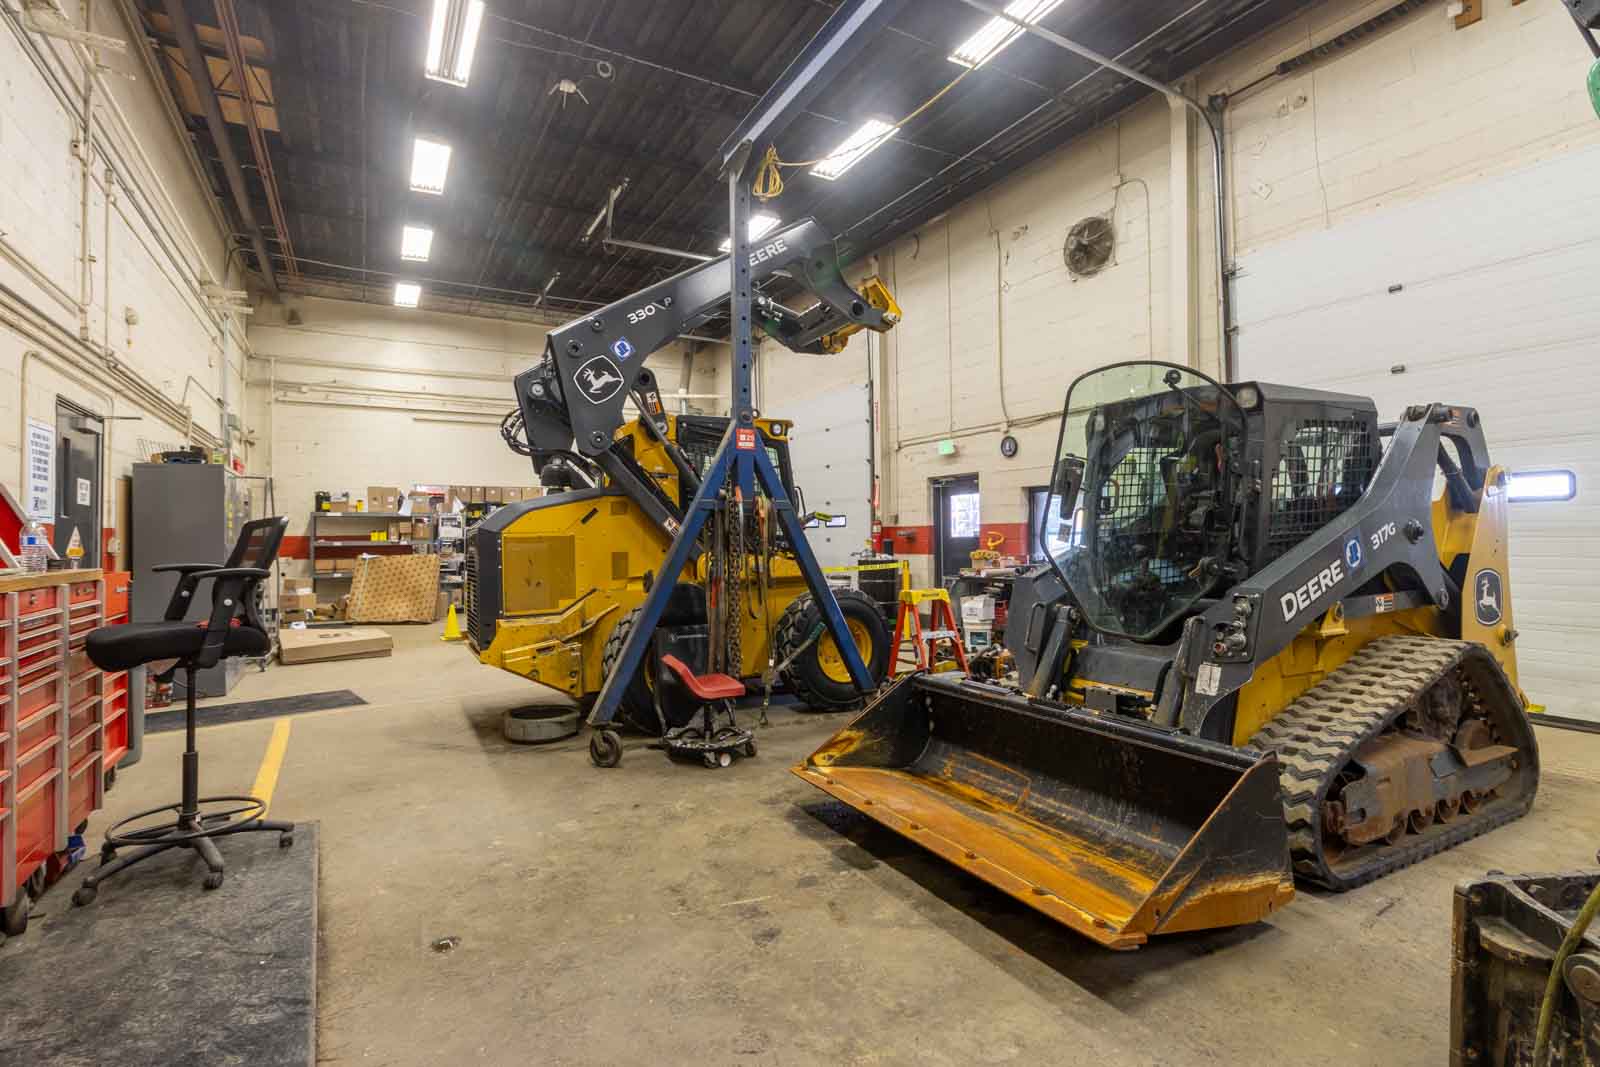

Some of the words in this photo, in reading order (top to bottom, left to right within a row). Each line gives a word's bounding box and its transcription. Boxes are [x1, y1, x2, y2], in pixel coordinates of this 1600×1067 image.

[749, 239, 788, 267] EERE
[626, 304, 656, 325] 330
[1370, 522, 1396, 550] 317G
[1280, 559, 1344, 622] DEERE
